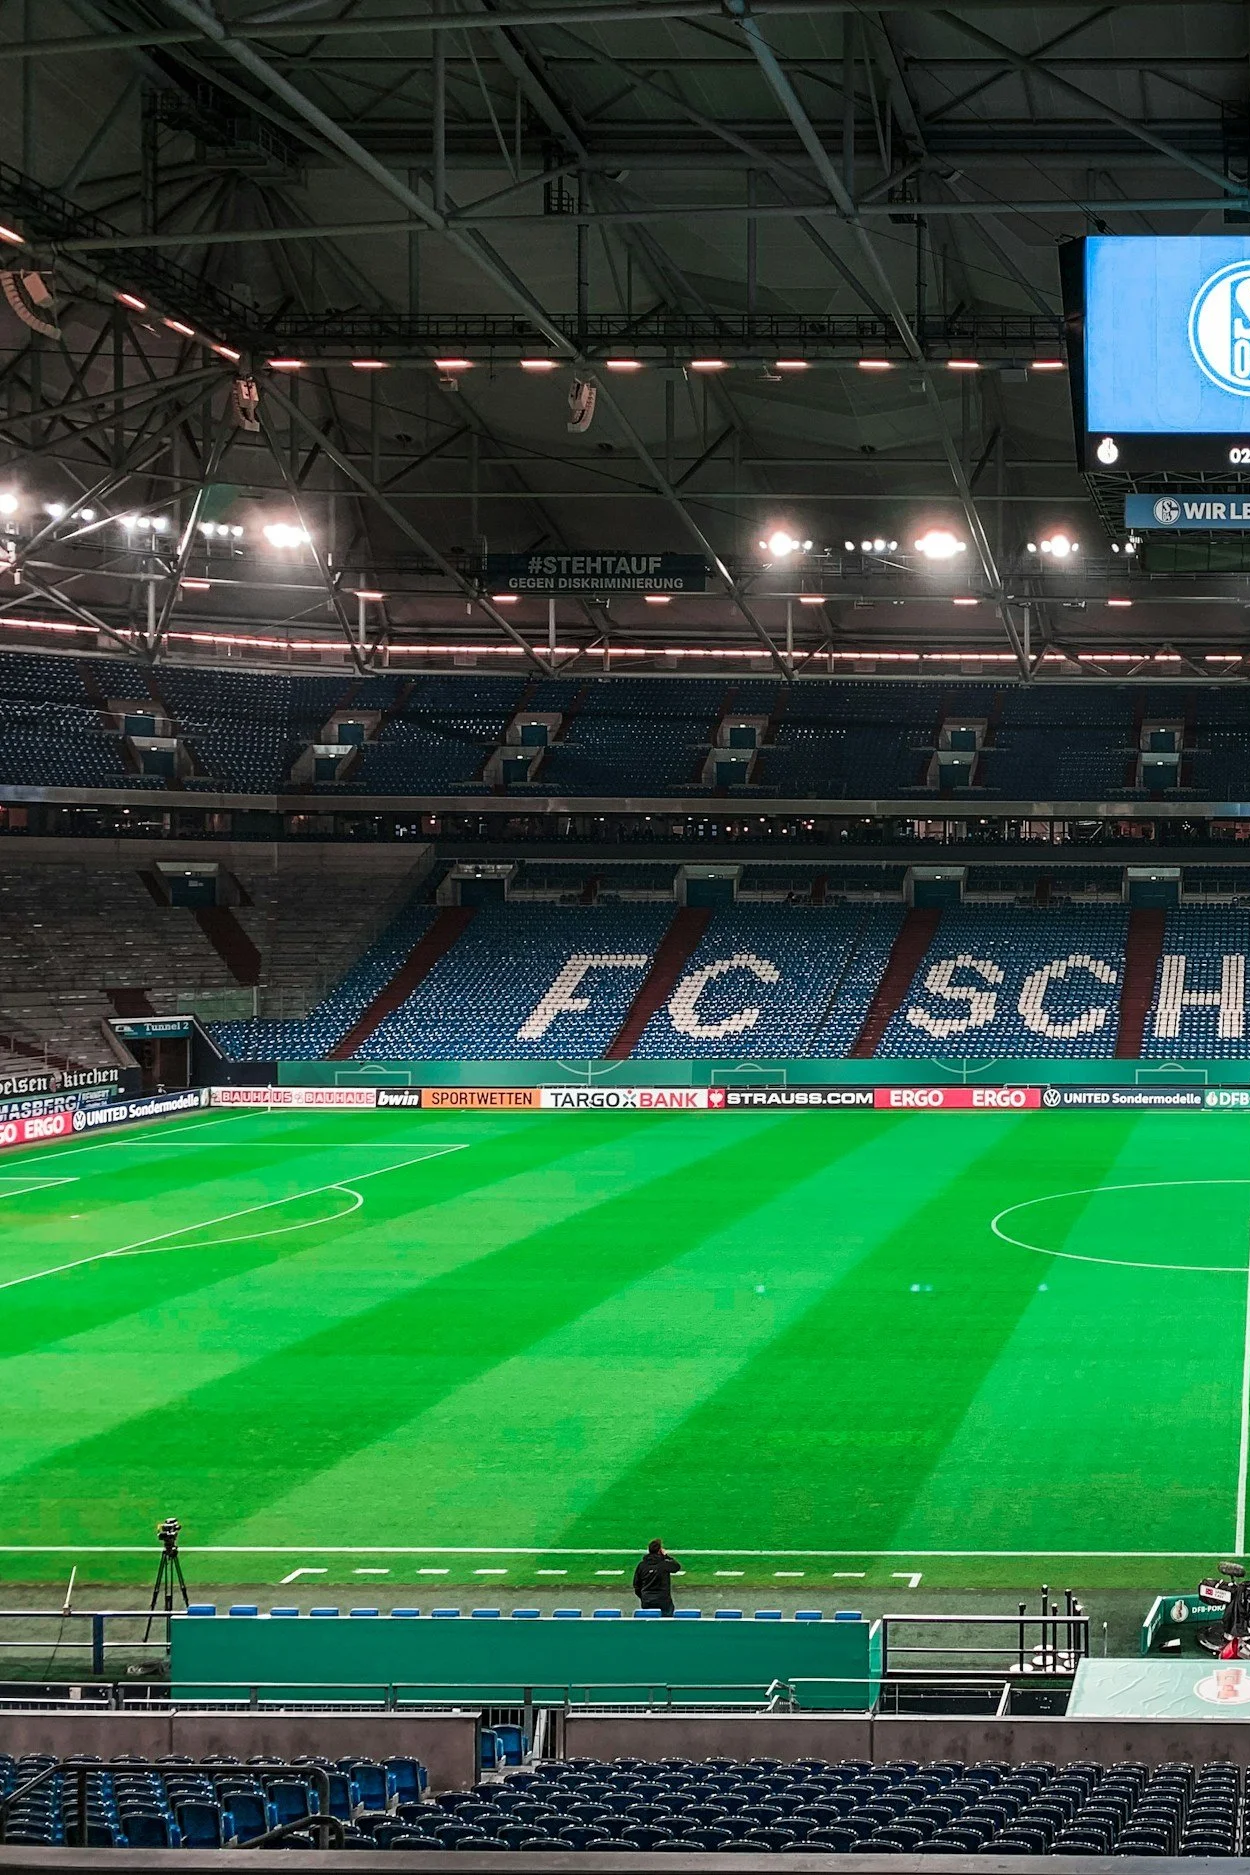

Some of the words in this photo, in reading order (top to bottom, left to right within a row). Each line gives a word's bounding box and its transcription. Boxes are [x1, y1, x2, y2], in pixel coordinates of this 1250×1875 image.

[1183, 502, 1228, 520] WIR
[528, 556, 662, 575] #STEHTAUF
[508, 577, 557, 589] GEGEN
[558, 577, 683, 589] DISKRIMINIERUNG
[514, 953, 782, 1042] FC
[144, 1022, 180, 1032] Tunnel
[183, 1022, 190, 1030] 2
[221, 1090, 292, 1104] BAUHAUS
[304, 1091, 376, 1105] BAUHAUS
[377, 1091, 419, 1106] bwin
[431, 1091, 532, 1105] SPORTWETTEN
[727, 1092, 874, 1105] STRAUSS.COM
[890, 1091, 944, 1107] ERGO
[972, 1091, 1026, 1107] ERGO
[1064, 1093, 1110, 1104] UNITED
[1112, 1092, 1201, 1105] Sondermodelle
[87, 1106, 128, 1126] UNITED
[129, 1093, 200, 1119] Sondermodelle
[24, 1115, 65, 1139] ERGO
